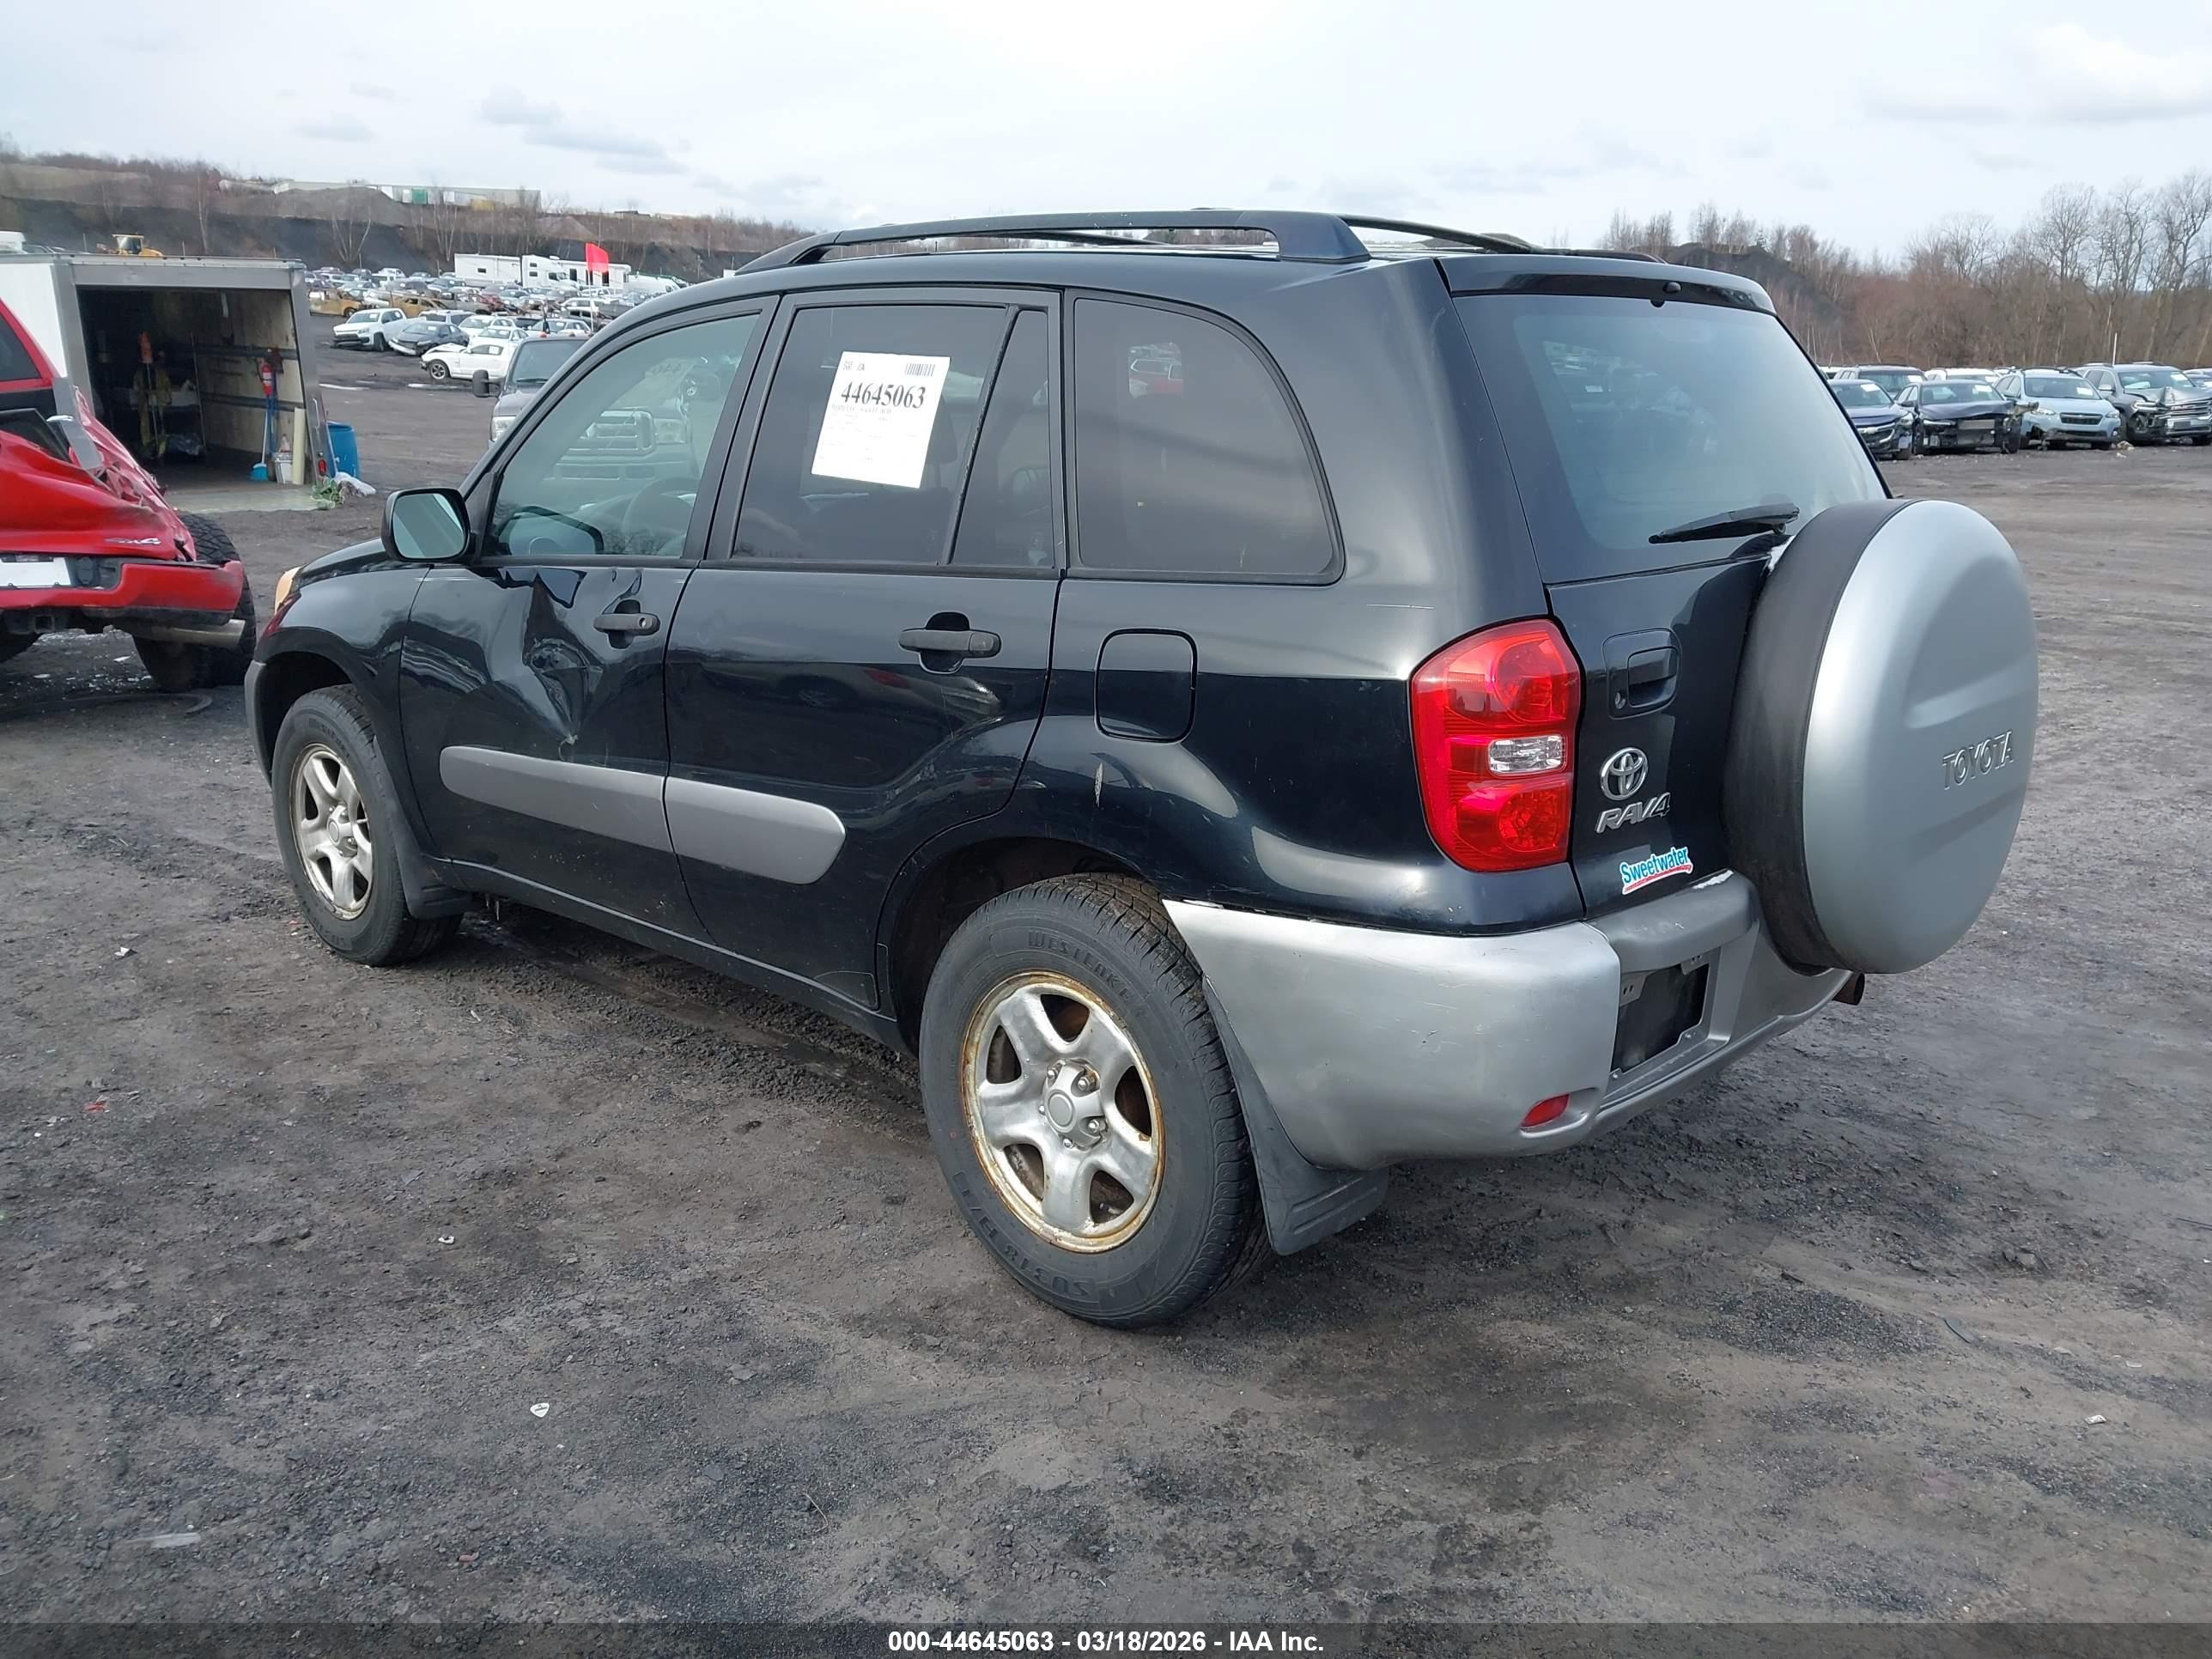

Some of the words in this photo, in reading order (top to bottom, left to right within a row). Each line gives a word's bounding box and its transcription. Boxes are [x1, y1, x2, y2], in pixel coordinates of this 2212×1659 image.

[842, 381, 927, 410] 44645063
[1942, 730, 2014, 790] TOYOTA
[1595, 792, 1671, 834] RAV4
[1621, 848, 1689, 884] Sweetwater
[1028, 930, 1133, 1000] WESTLAKE
